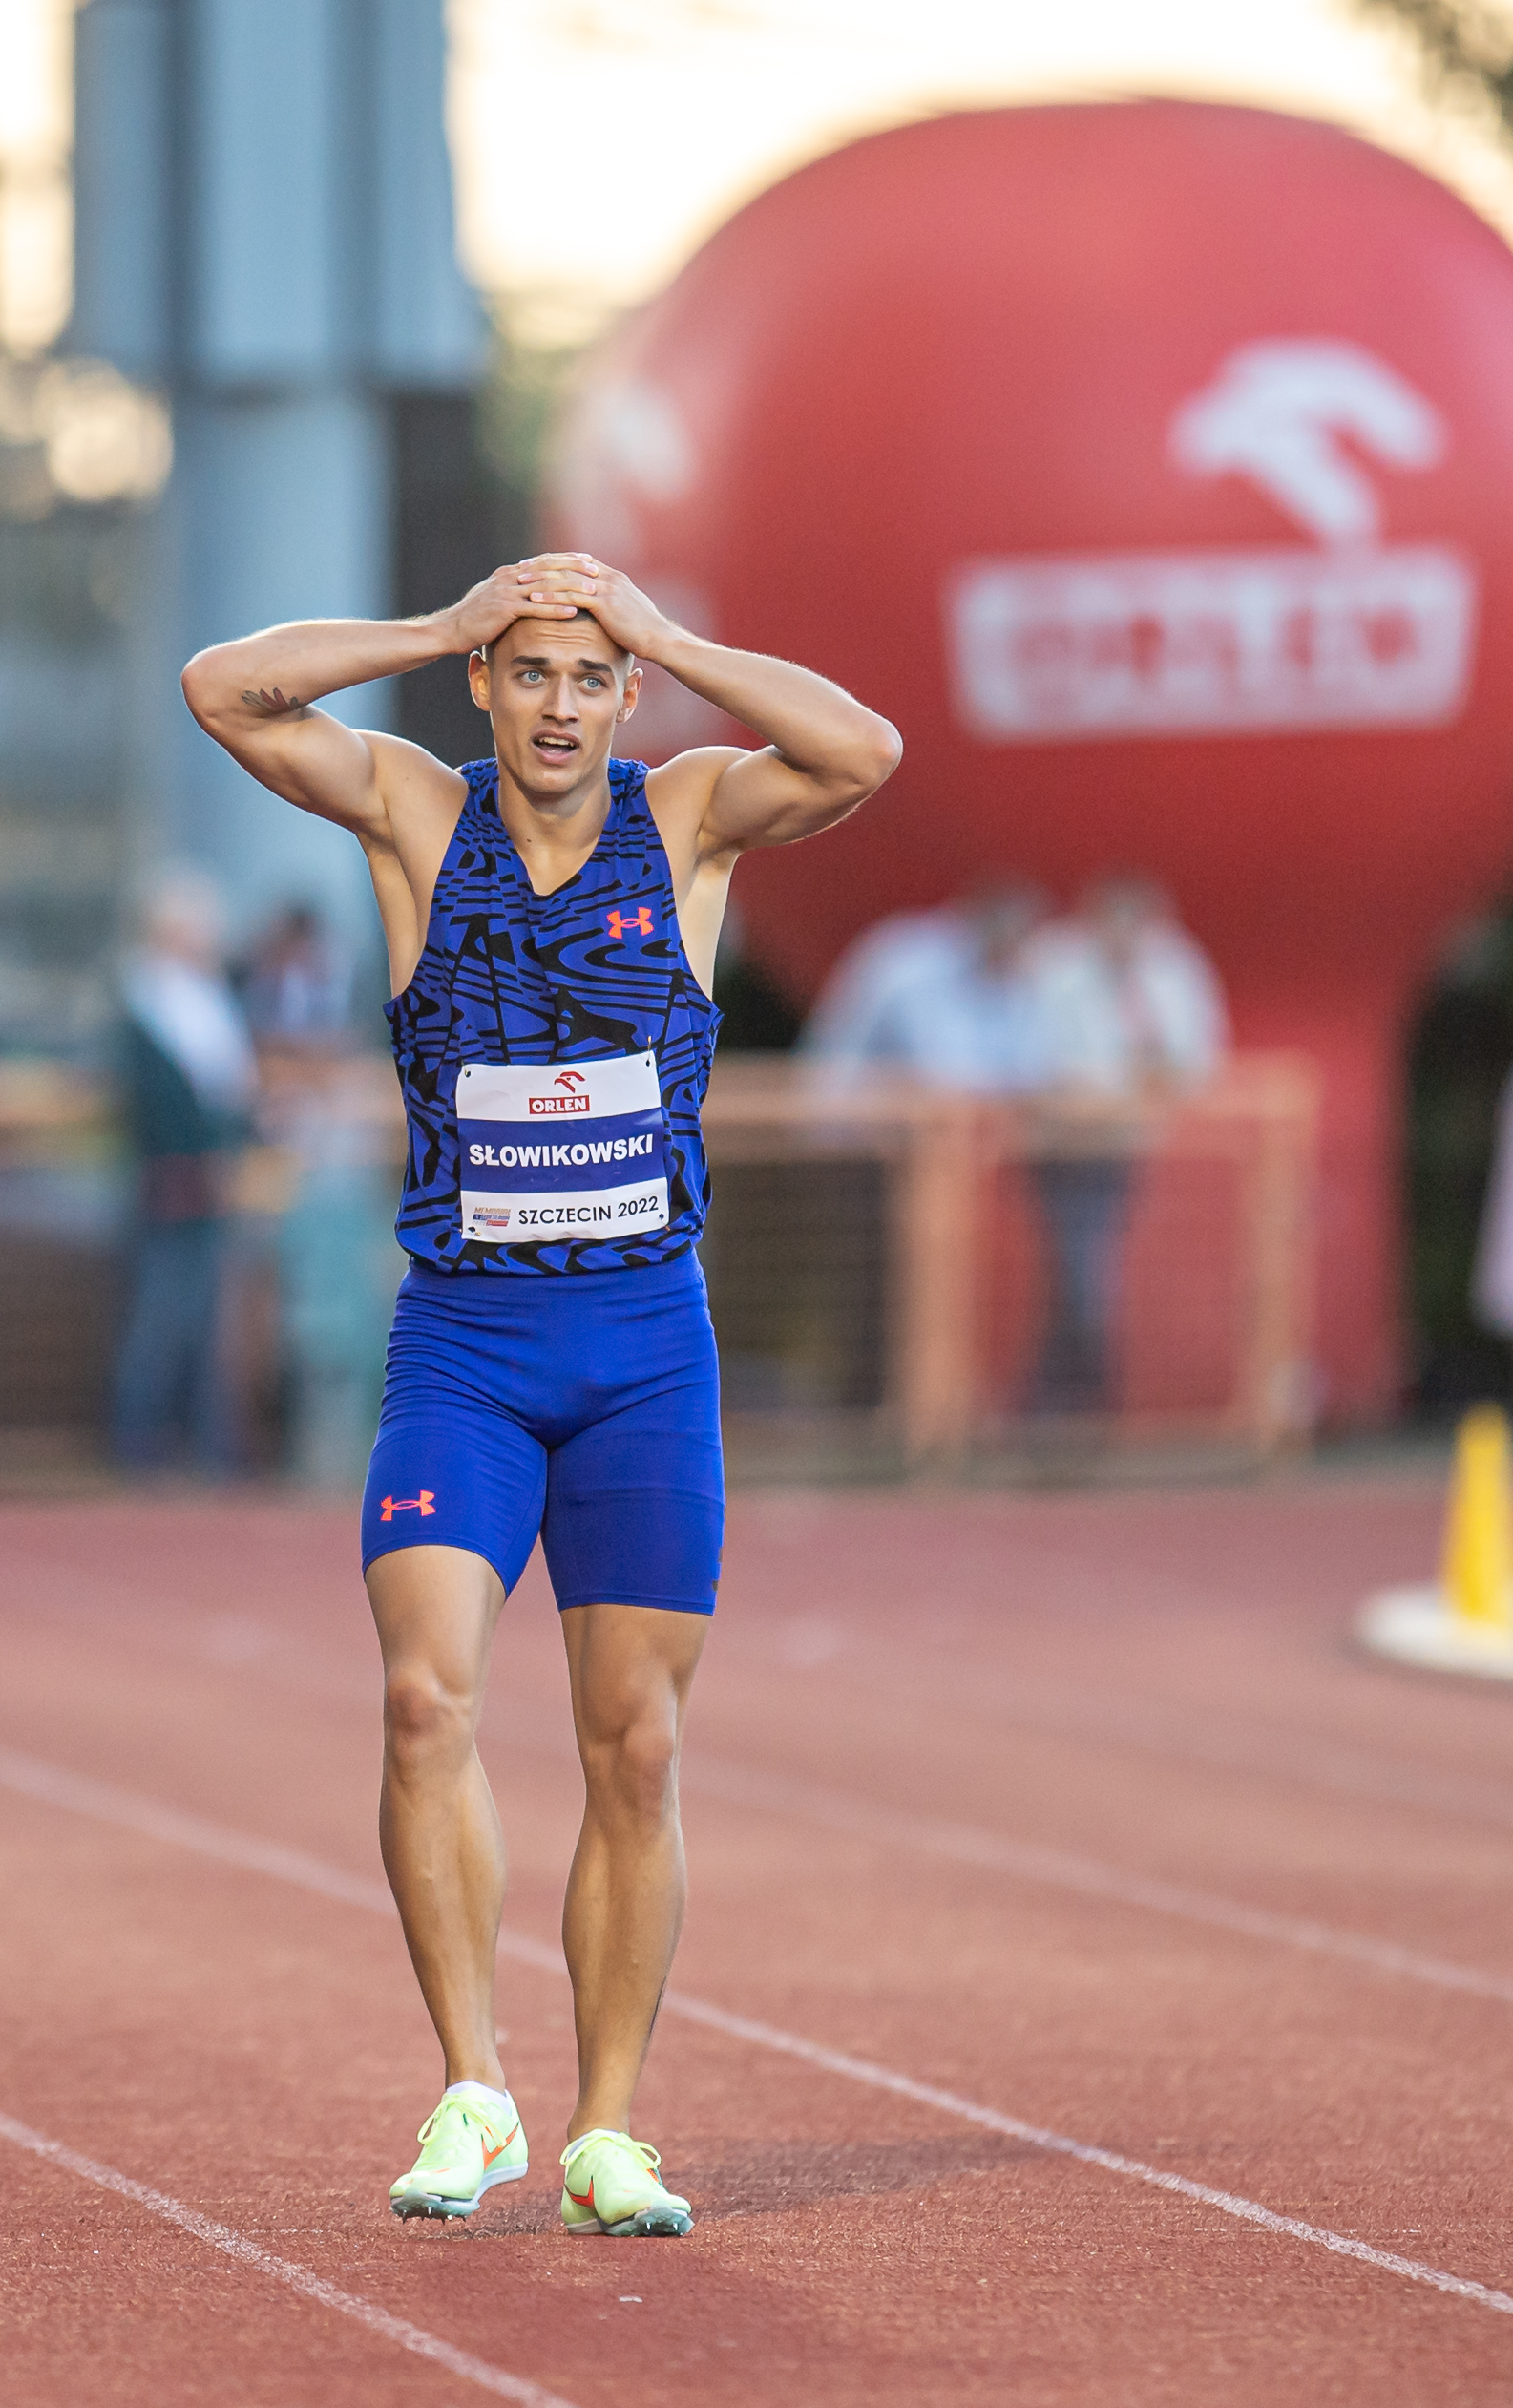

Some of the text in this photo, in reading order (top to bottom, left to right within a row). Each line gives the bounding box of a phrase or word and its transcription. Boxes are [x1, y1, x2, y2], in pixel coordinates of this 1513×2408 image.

[532, 1097, 587, 1113] ORLEN
[469, 1133, 653, 1168] SŁOWIKOWSKI
[518, 1195, 659, 1225] SZCZECIN 2022
